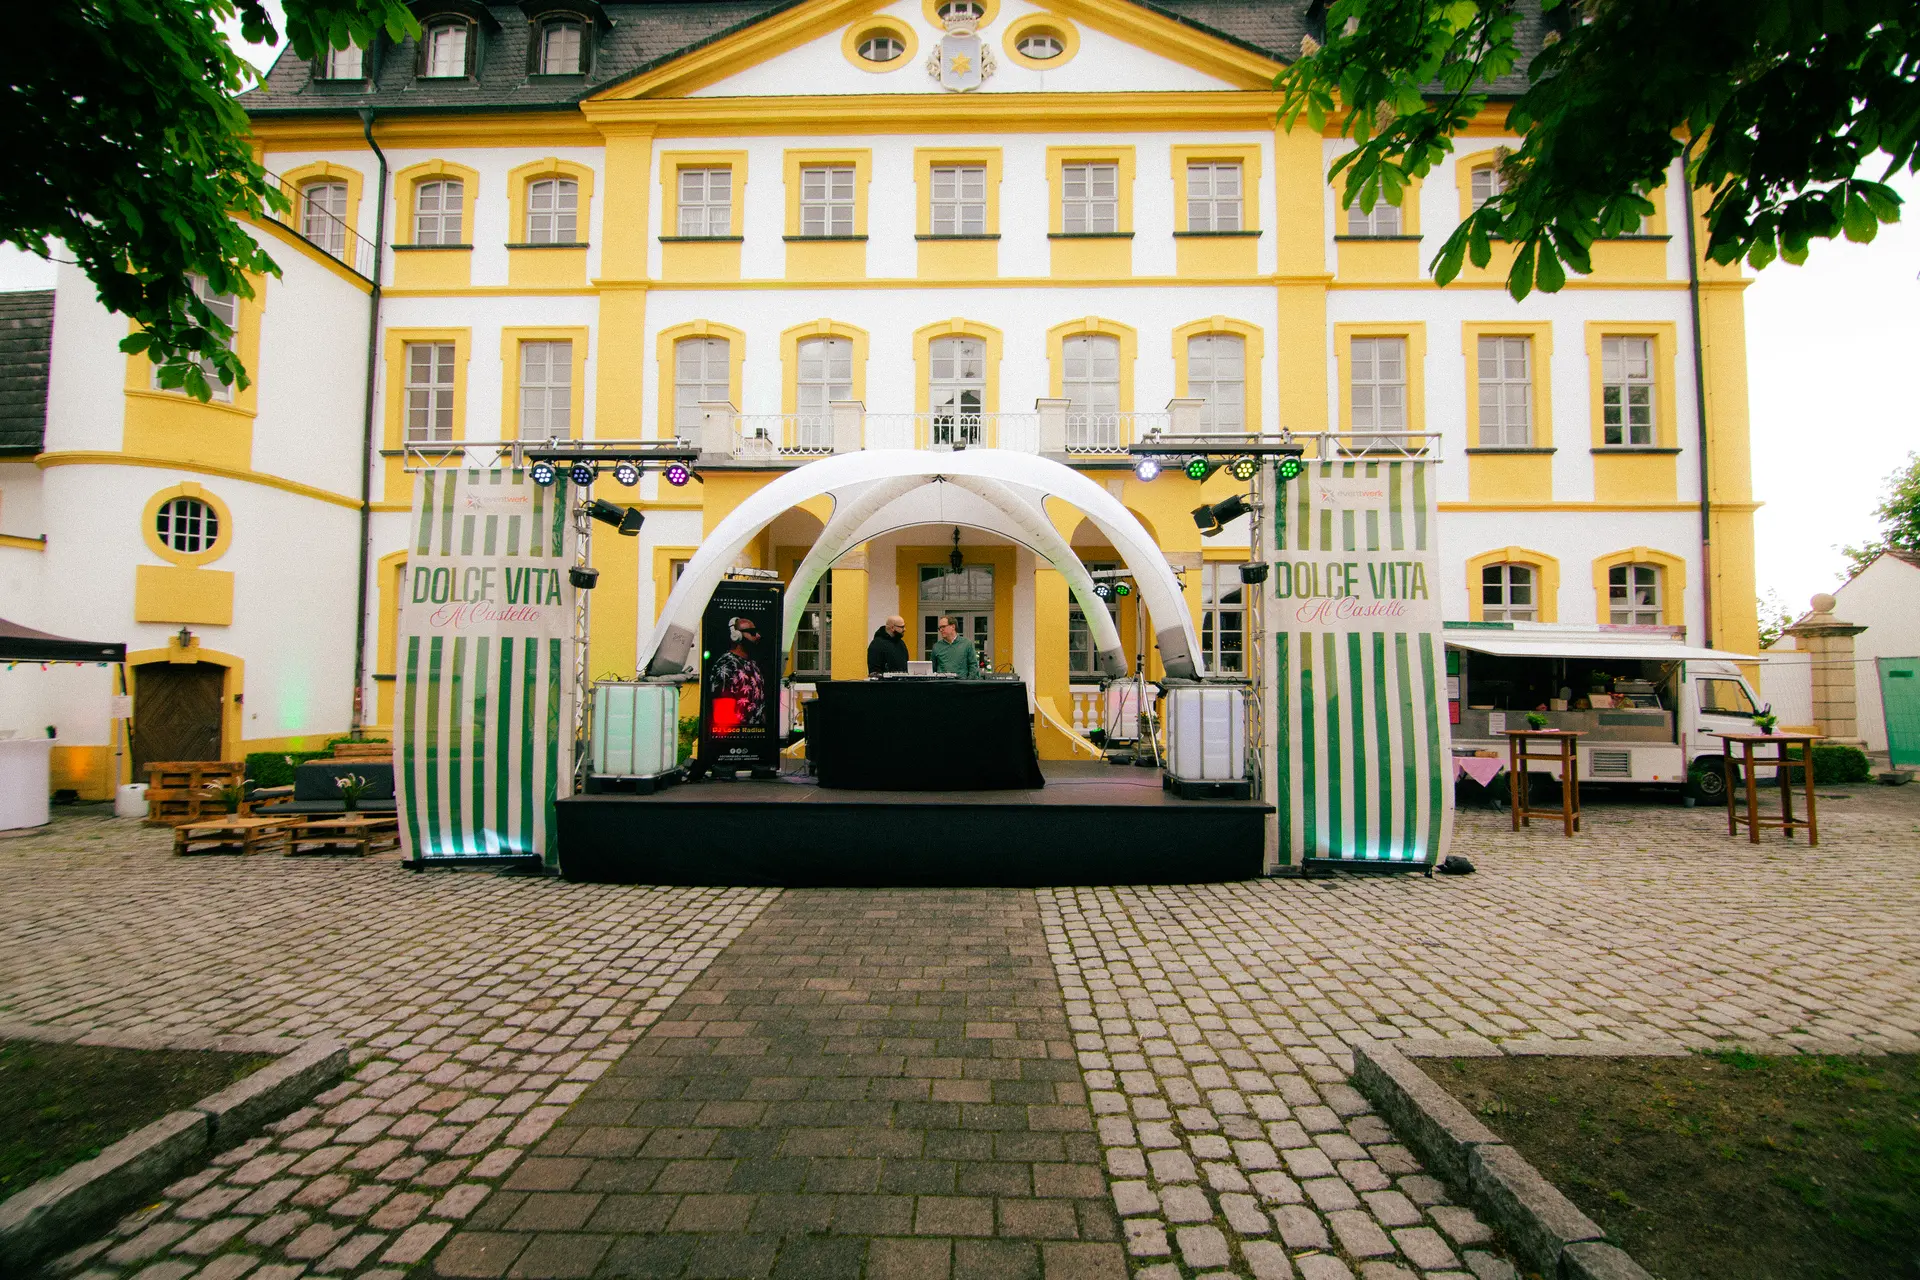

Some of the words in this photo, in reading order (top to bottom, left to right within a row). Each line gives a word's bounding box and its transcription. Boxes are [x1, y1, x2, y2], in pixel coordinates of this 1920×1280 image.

[1337, 489, 1383, 498] eventwerk
[412, 566, 497, 604] DOLCE
[505, 566, 562, 606] VITA
[1274, 561, 1360, 600] DOLCE
[1368, 561, 1429, 600] VITA
[430, 603, 468, 629] Al
[470, 600, 541, 623] Castello
[1296, 598, 1335, 626] Al
[1336, 596, 1407, 619] Castello
